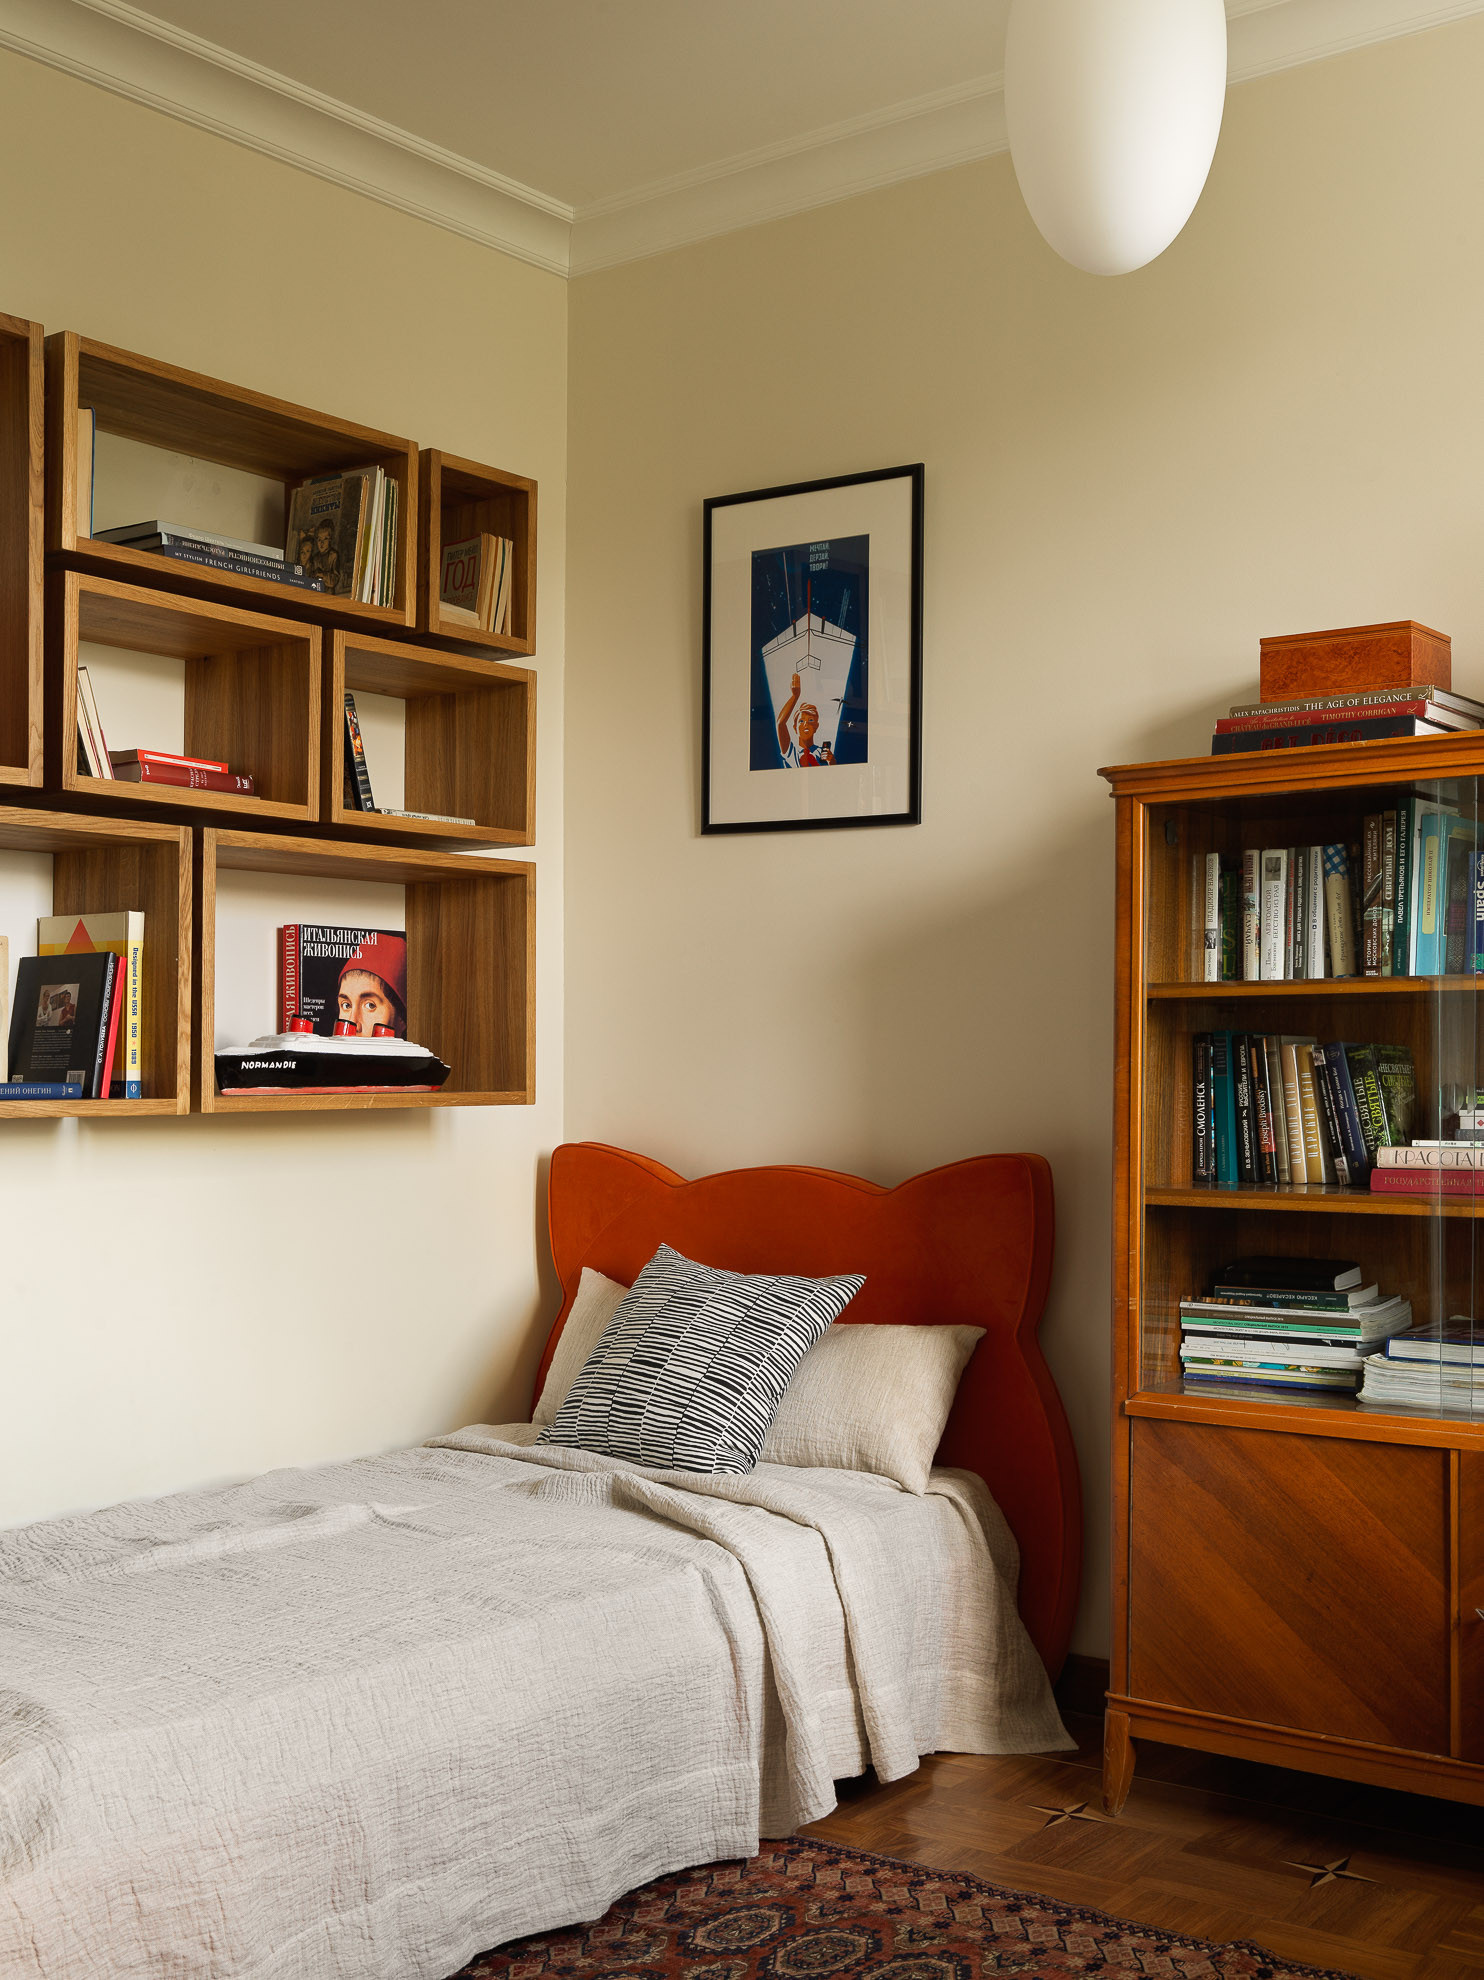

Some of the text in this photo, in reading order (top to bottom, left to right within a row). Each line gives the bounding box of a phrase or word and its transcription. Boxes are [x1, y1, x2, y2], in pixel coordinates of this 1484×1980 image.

[183, 552, 203, 562] STYLISH
[205, 557, 233, 570] FRENCH
[235, 564, 281, 581] GIRLFRIENDS
[443, 555, 477, 594] ГОД
[1251, 705, 1300, 716] PAPACHRISTIDIS
[1304, 701, 1324, 711] THE
[1326, 699, 1345, 709] AGE
[1346, 697, 1360, 706] OF
[1363, 692, 1412, 705] ELEGANCE
[1321, 710, 1355, 721] TIMOTHY
[1357, 707, 1397, 718] CORRIGAN
[1367, 830, 1372, 838] ИХ
[1383, 826, 1393, 901] СЕВЕРНЫЙ ДОМ
[1273, 899, 1279, 908] ИЗ
[1473, 881, 1484, 921] Spain
[303, 927, 378, 946] ИТАЛЬЯНСКАЯ
[131, 947, 139, 978] Designed
[285, 925, 296, 999] ЖИВОПИСЬ
[303, 942, 363, 959] ЖИВОПИСЬ
[105, 962, 115, 998] КОМПОЗИЦИИ
[131, 978, 138, 986] in
[102, 998, 111, 1022] ОСНОВЫ
[98, 1025, 107, 1052] ГОЛУБЕВА
[241, 1061, 297, 1070] NORMANDIE
[1239, 1044, 1247, 1066] ЕВРОПА
[22, 1087, 52, 1095] ОНЕГИН
[1258, 1090, 1267, 1118] Brodsky
[1364, 1070, 1383, 1127] СВЯТЫЕ»
[1196, 1082, 1206, 1136] СМОЛЕНСК
[1301, 1072, 1319, 1158] ЦАРСКИЕ ДЕТИ
[1354, 1077, 1376, 1151] «НЕСВЯТЫЕ
[1260, 1119, 1271, 1145] Joseph
[1285, 1082, 1302, 1164] ЦАРСКИЕ ДЕТИ
[1242, 1120, 1250, 1158] ЗЕНЬКОВСКИЙ
[1395, 1150, 1474, 1166] КРАСОТА
[1384, 1176, 1473, 1187] ГОСУДАРСТВЕННАЯ
